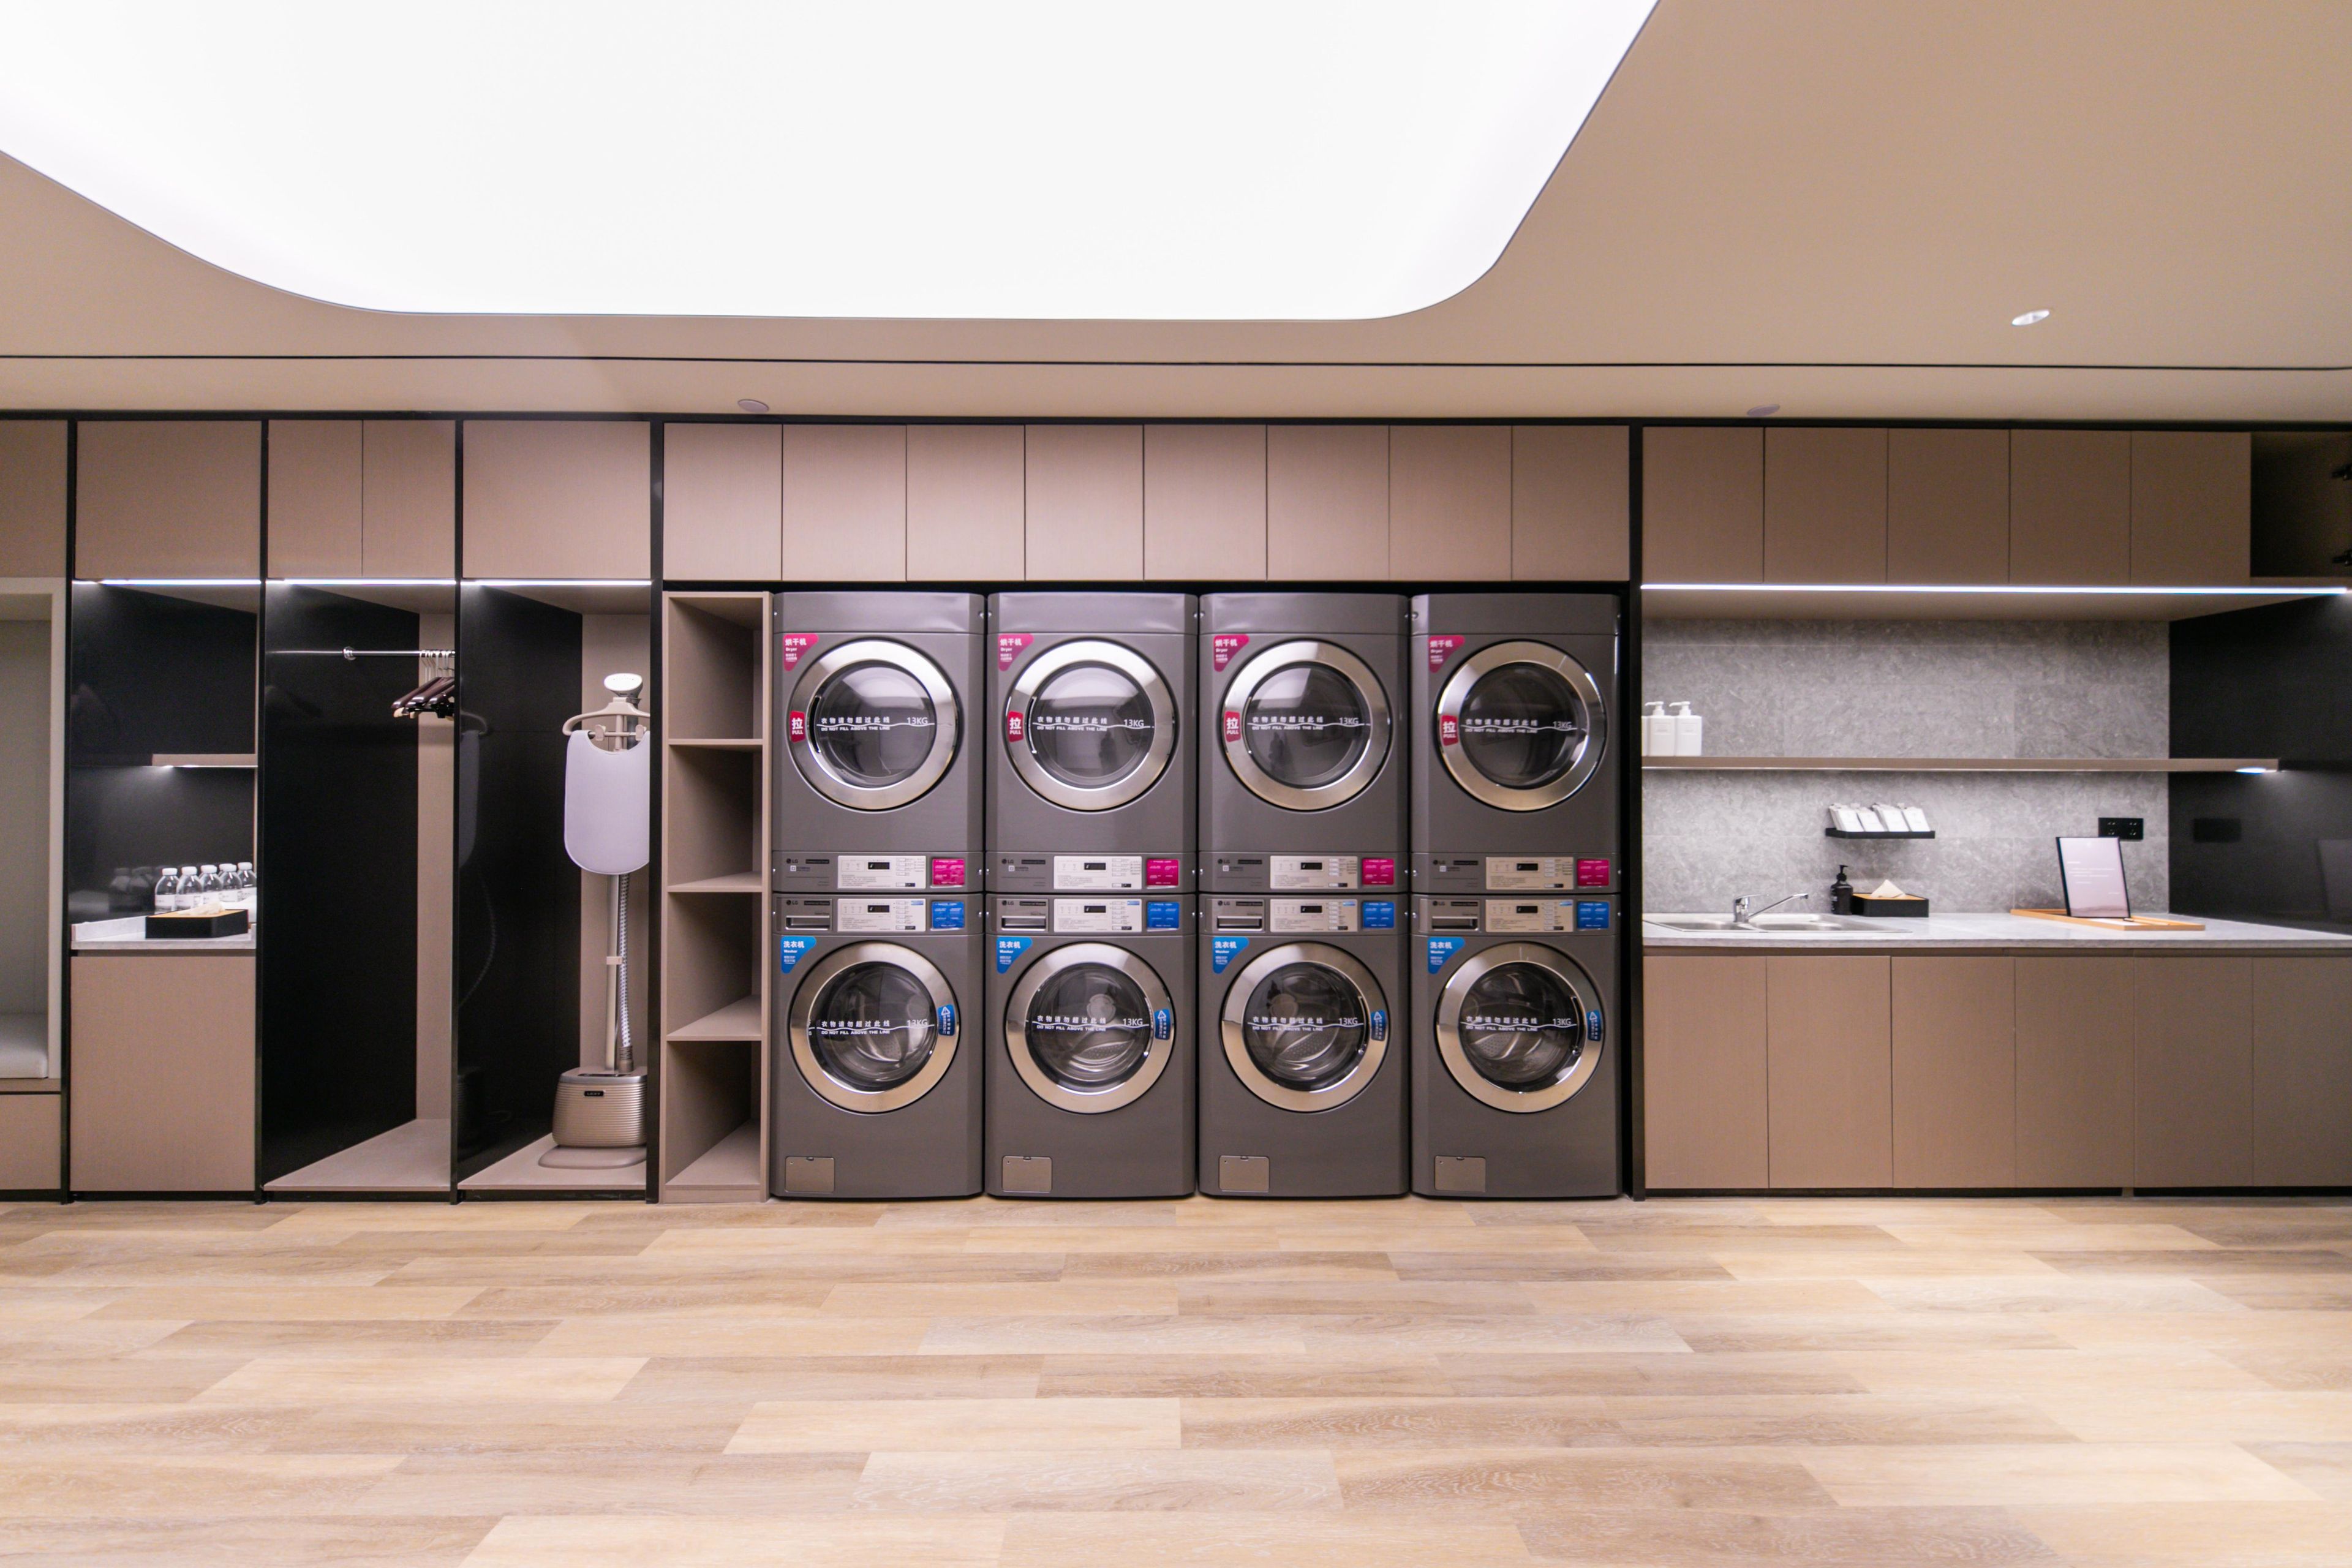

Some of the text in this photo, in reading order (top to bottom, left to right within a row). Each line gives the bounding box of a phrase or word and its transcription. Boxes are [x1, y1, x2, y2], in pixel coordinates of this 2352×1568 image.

[791, 717, 804, 729] 拉
[1009, 717, 1022, 729] 拉
[1226, 717, 1238, 729] 拉
[1443, 722, 1456, 733] 拉
